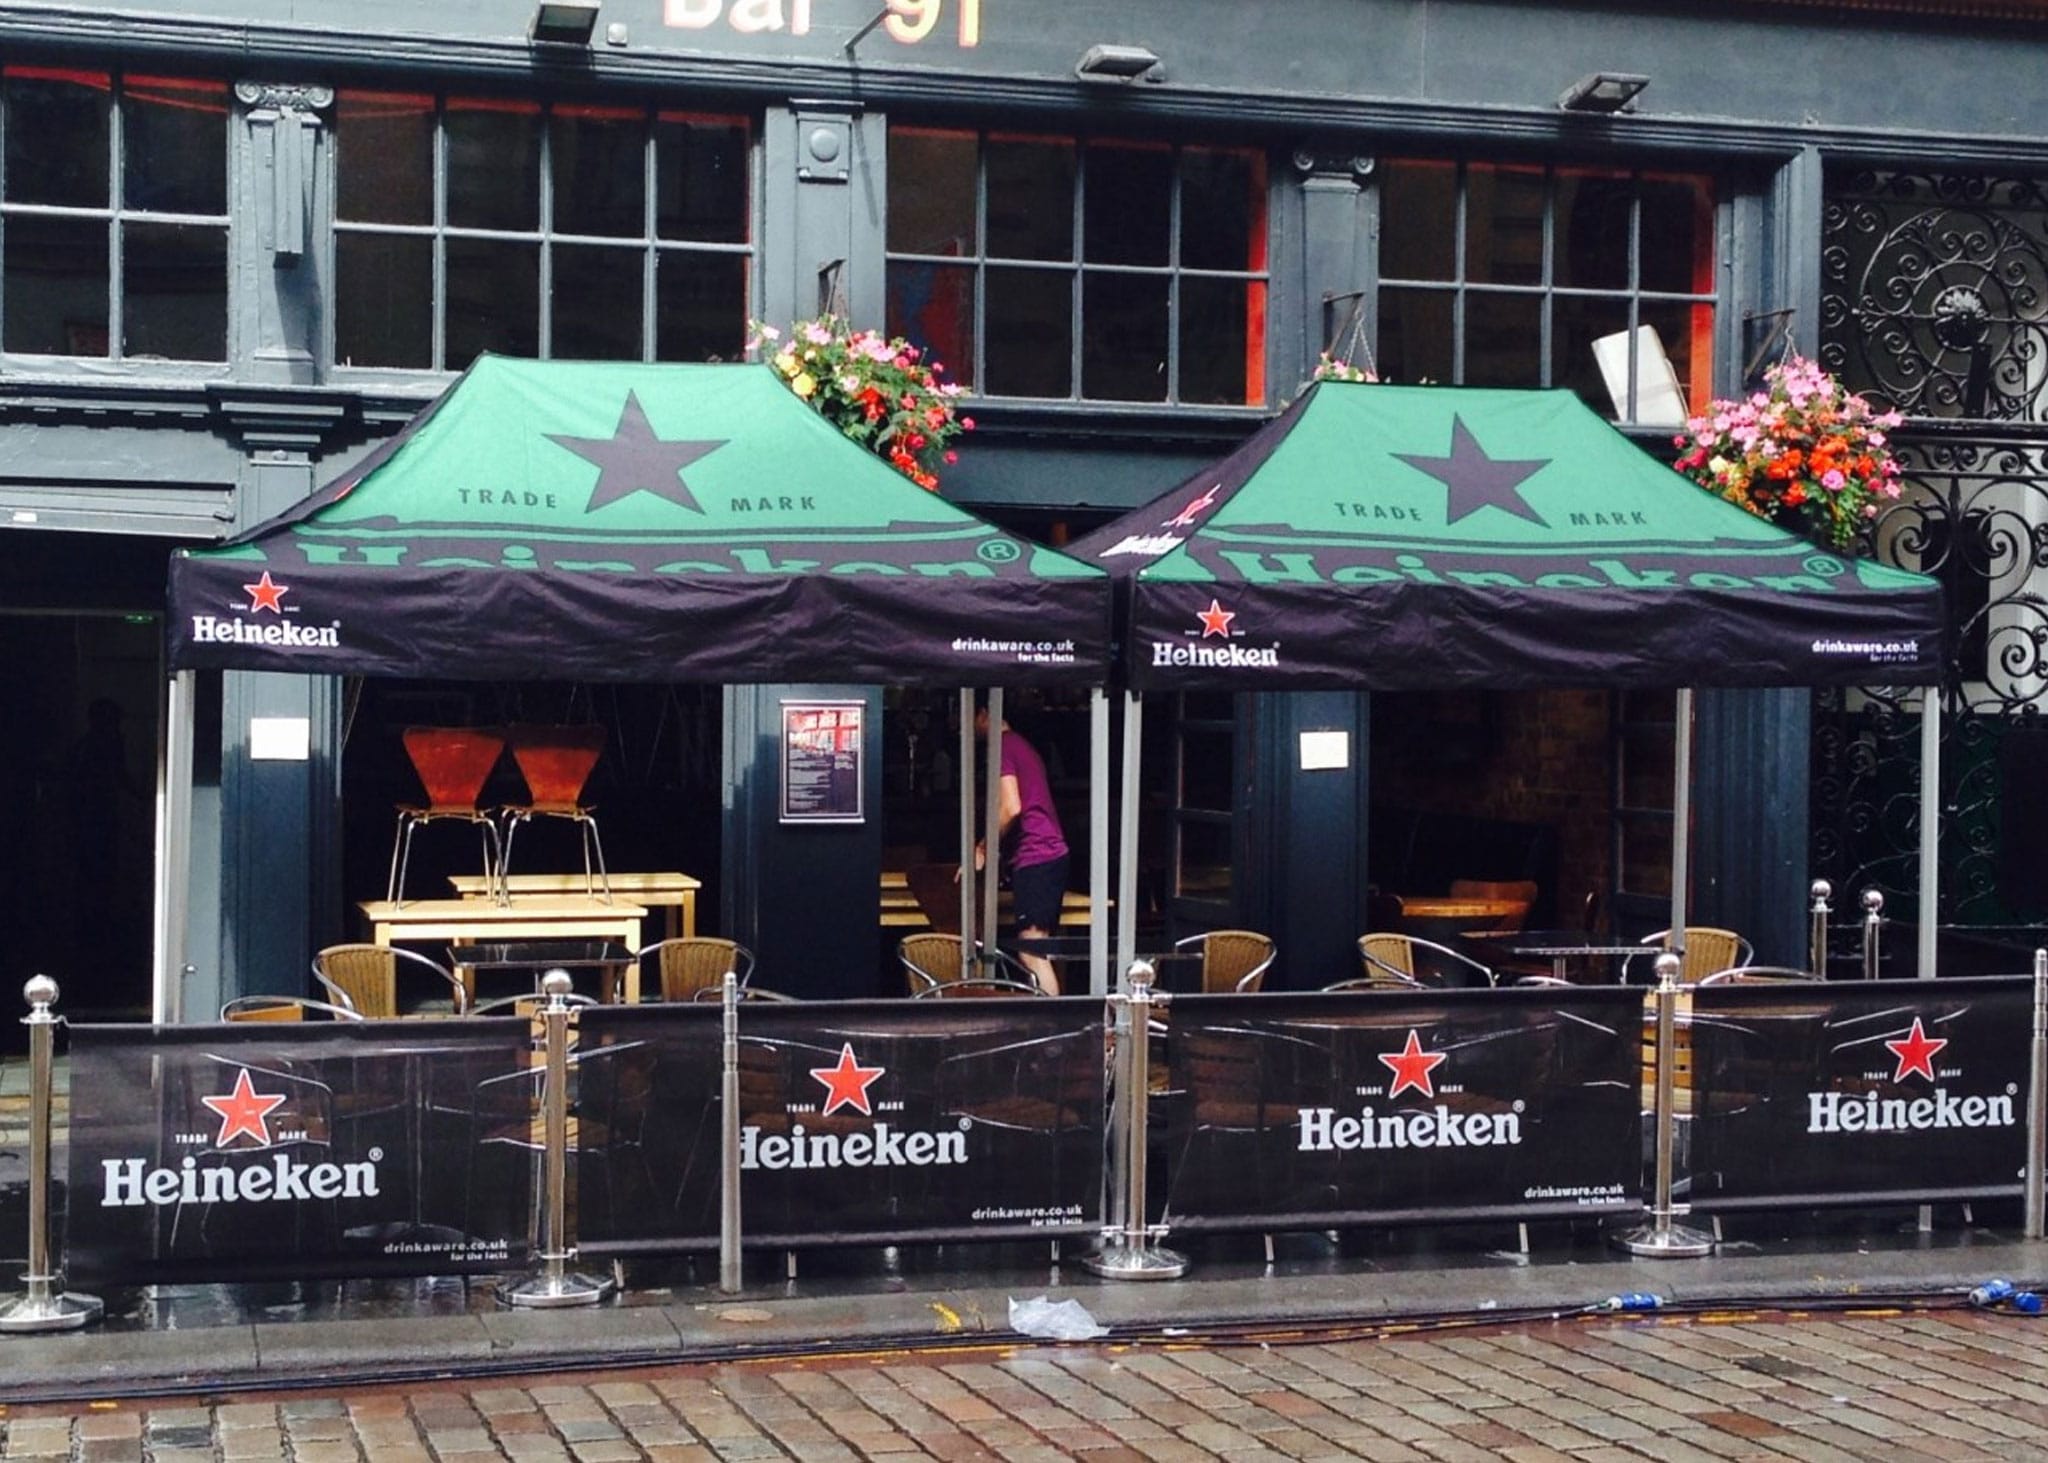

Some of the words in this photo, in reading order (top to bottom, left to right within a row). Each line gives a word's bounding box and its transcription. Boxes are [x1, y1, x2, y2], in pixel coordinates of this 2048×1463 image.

[458, 487, 558, 509] TRADE
[730, 496, 817, 513] MARK
[1334, 502, 1423, 522] TRADE
[1569, 511, 1648, 527] MARK
[191, 615, 340, 648] Heineken
[951, 637, 1075, 652] drinkaware.co.uk
[1151, 641, 1280, 667] Heineken
[1811, 639, 1919, 653] drinkaware.co.uk
[1806, 1088, 2016, 1133] Heineken
[1297, 1105, 1523, 1151] Heineken
[101, 1154, 380, 1207] Heineken
[1523, 1182, 1625, 1199] drinkaware.co.uk
[971, 1203, 1083, 1220] drinkaware.co.uk
[383, 1238, 509, 1254] drinkaware.co.uk
